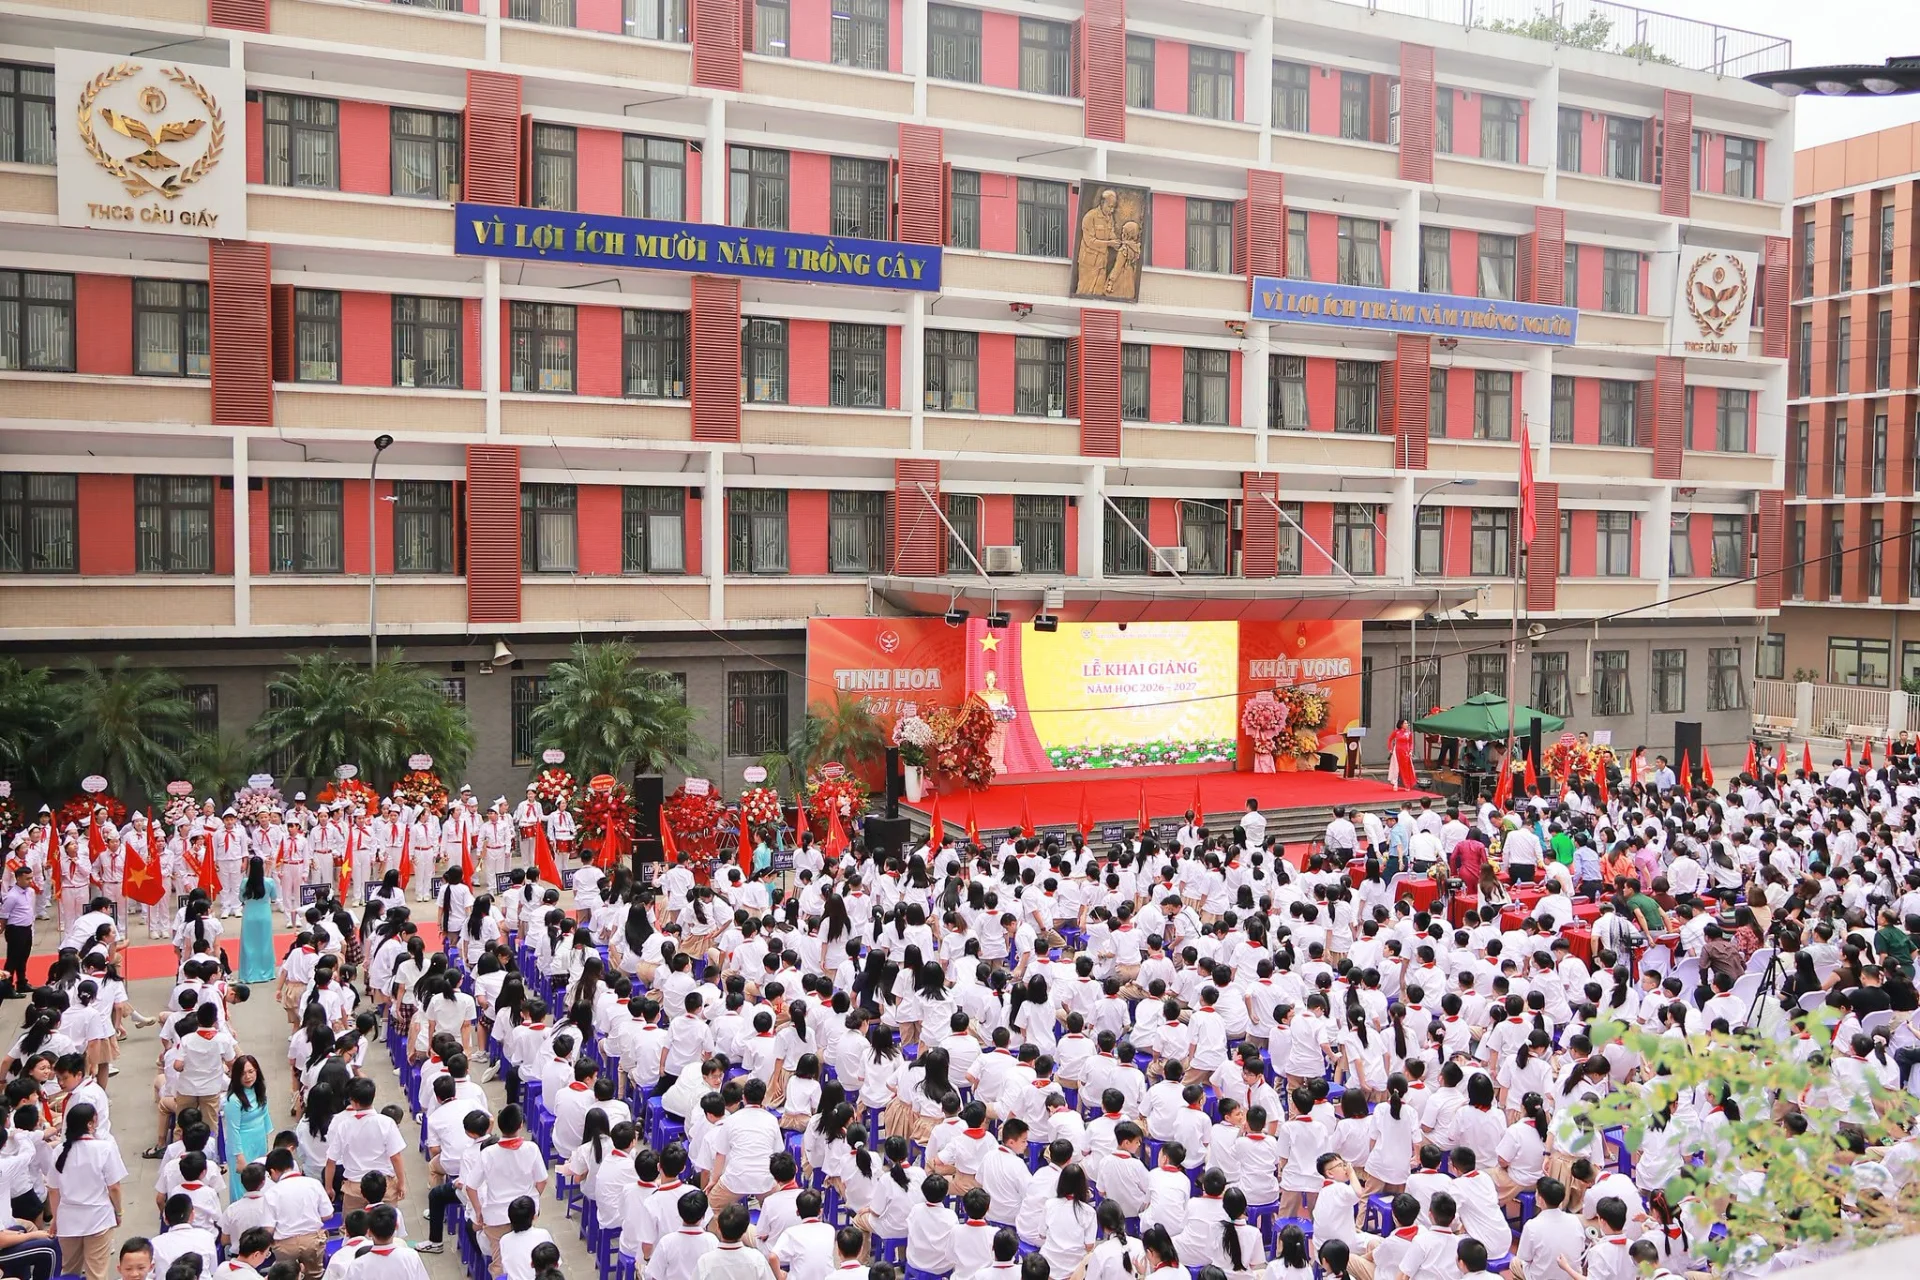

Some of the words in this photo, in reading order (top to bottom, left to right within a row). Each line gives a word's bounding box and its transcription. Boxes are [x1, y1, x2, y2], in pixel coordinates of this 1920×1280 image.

[87, 203, 135, 221] THCS
[140, 203, 174, 224] CẦU
[179, 208, 219, 228] GIẤY
[472, 214, 506, 247] VÌ
[514, 223, 565, 255] LỢI
[574, 221, 625, 255] ÍCH
[634, 230, 707, 262] MƯỜI
[717, 236, 777, 268] NĂM
[784, 239, 871, 276] TRỒNG
[877, 251, 927, 281] CÂY
[1262, 287, 1284, 312] VÌ
[1287, 293, 1319, 318] LỢI
[1323, 292, 1357, 318] ÍCH
[1360, 299, 1416, 323] TRĂM
[1418, 304, 1459, 328] NĂM
[1461, 303, 1519, 332] TRỒNG
[1521, 314, 1573, 338] NGƯỜI
[835, 669, 890, 691] TINH
[894, 669, 942, 691] HOA
[1105, 663, 1144, 676] KHAI
[1148, 660, 1198, 675] GIẢNG
[1250, 653, 1299, 680] KHÁT
[1301, 657, 1351, 682] VỌNG
[1086, 684, 1112, 694] NĂM
[1115, 683, 1139, 695] HỌC
[1140, 683, 1164, 693] 2026
[1173, 682, 1197, 692] 2027
